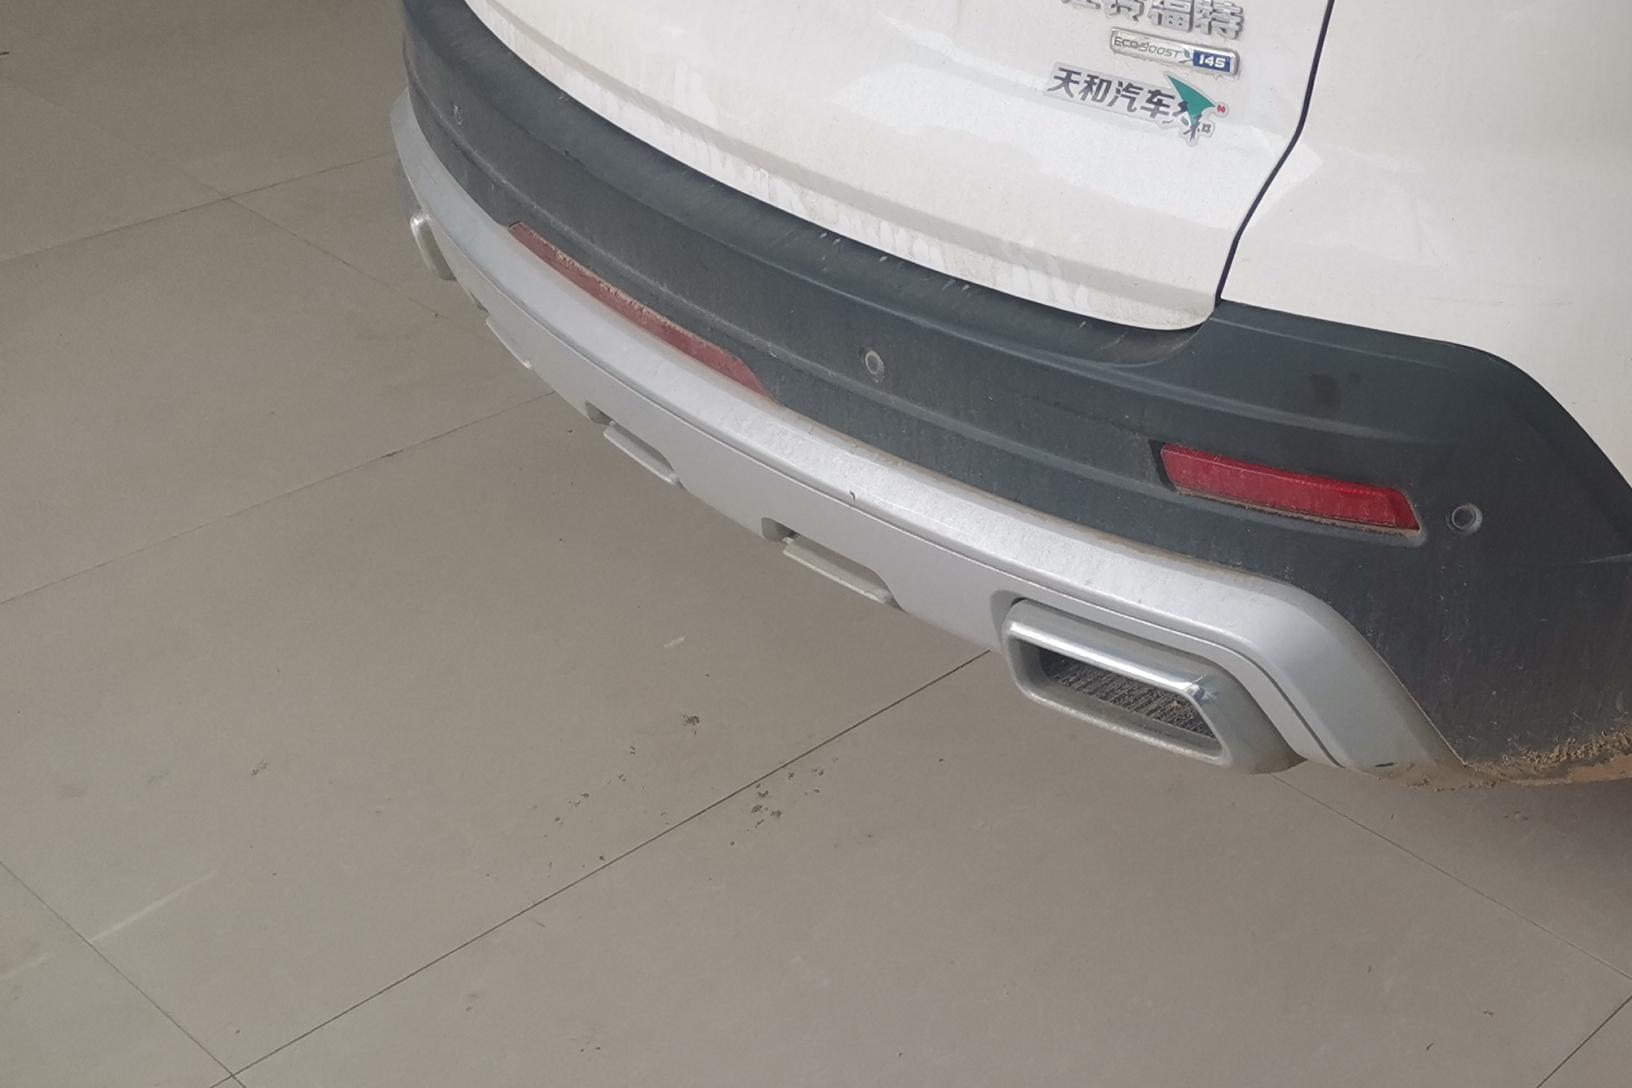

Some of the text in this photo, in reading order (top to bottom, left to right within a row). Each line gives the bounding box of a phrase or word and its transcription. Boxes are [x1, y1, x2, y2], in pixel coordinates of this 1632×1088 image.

[1198, 54, 1226, 69] 145
[1047, 67, 1176, 118] 天和汽车
